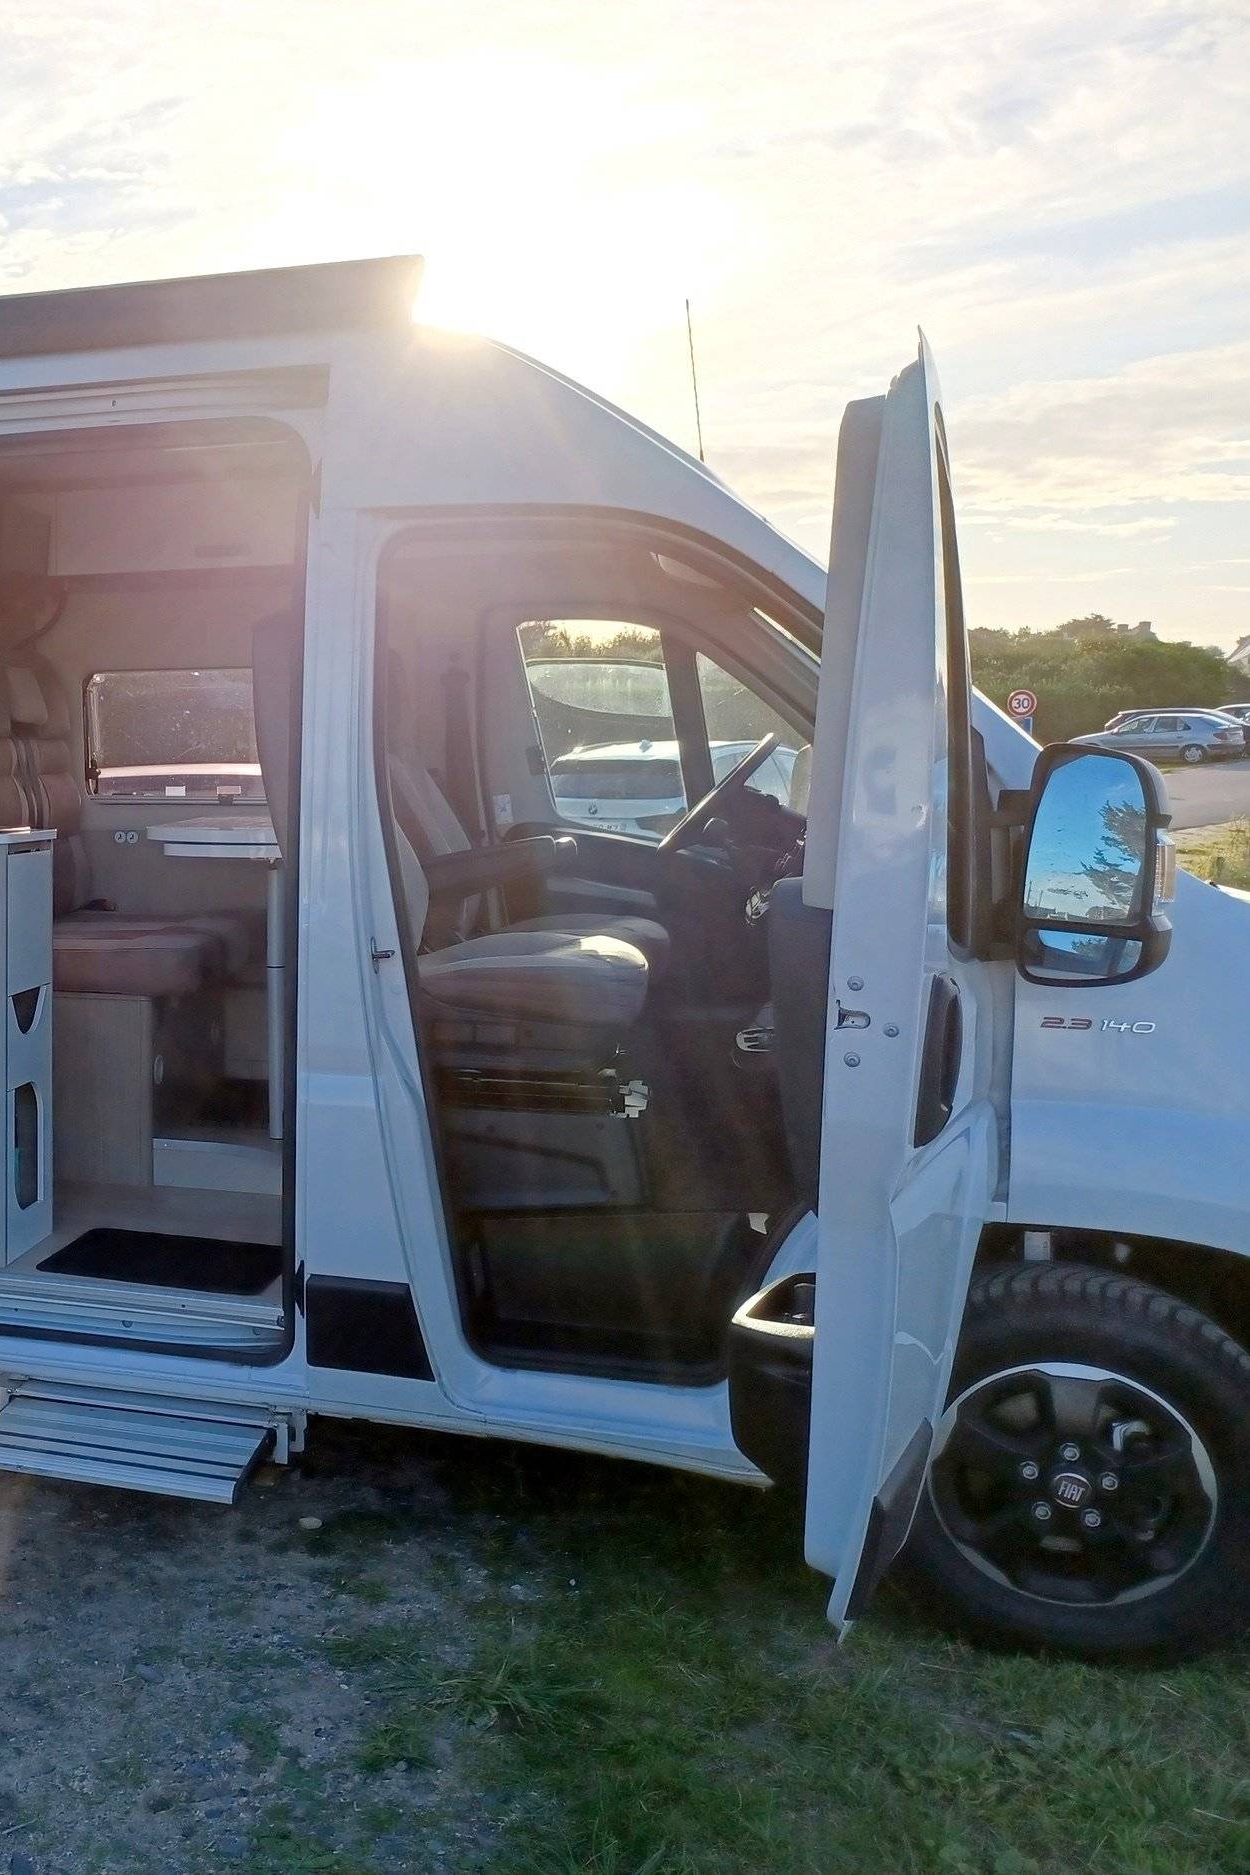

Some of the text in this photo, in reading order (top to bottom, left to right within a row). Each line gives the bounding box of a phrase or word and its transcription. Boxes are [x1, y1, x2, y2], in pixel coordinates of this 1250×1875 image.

[1013, 697, 1031, 710] 30
[1101, 1019, 1157, 1034] 140
[1057, 1480, 1087, 1502] FIAT
